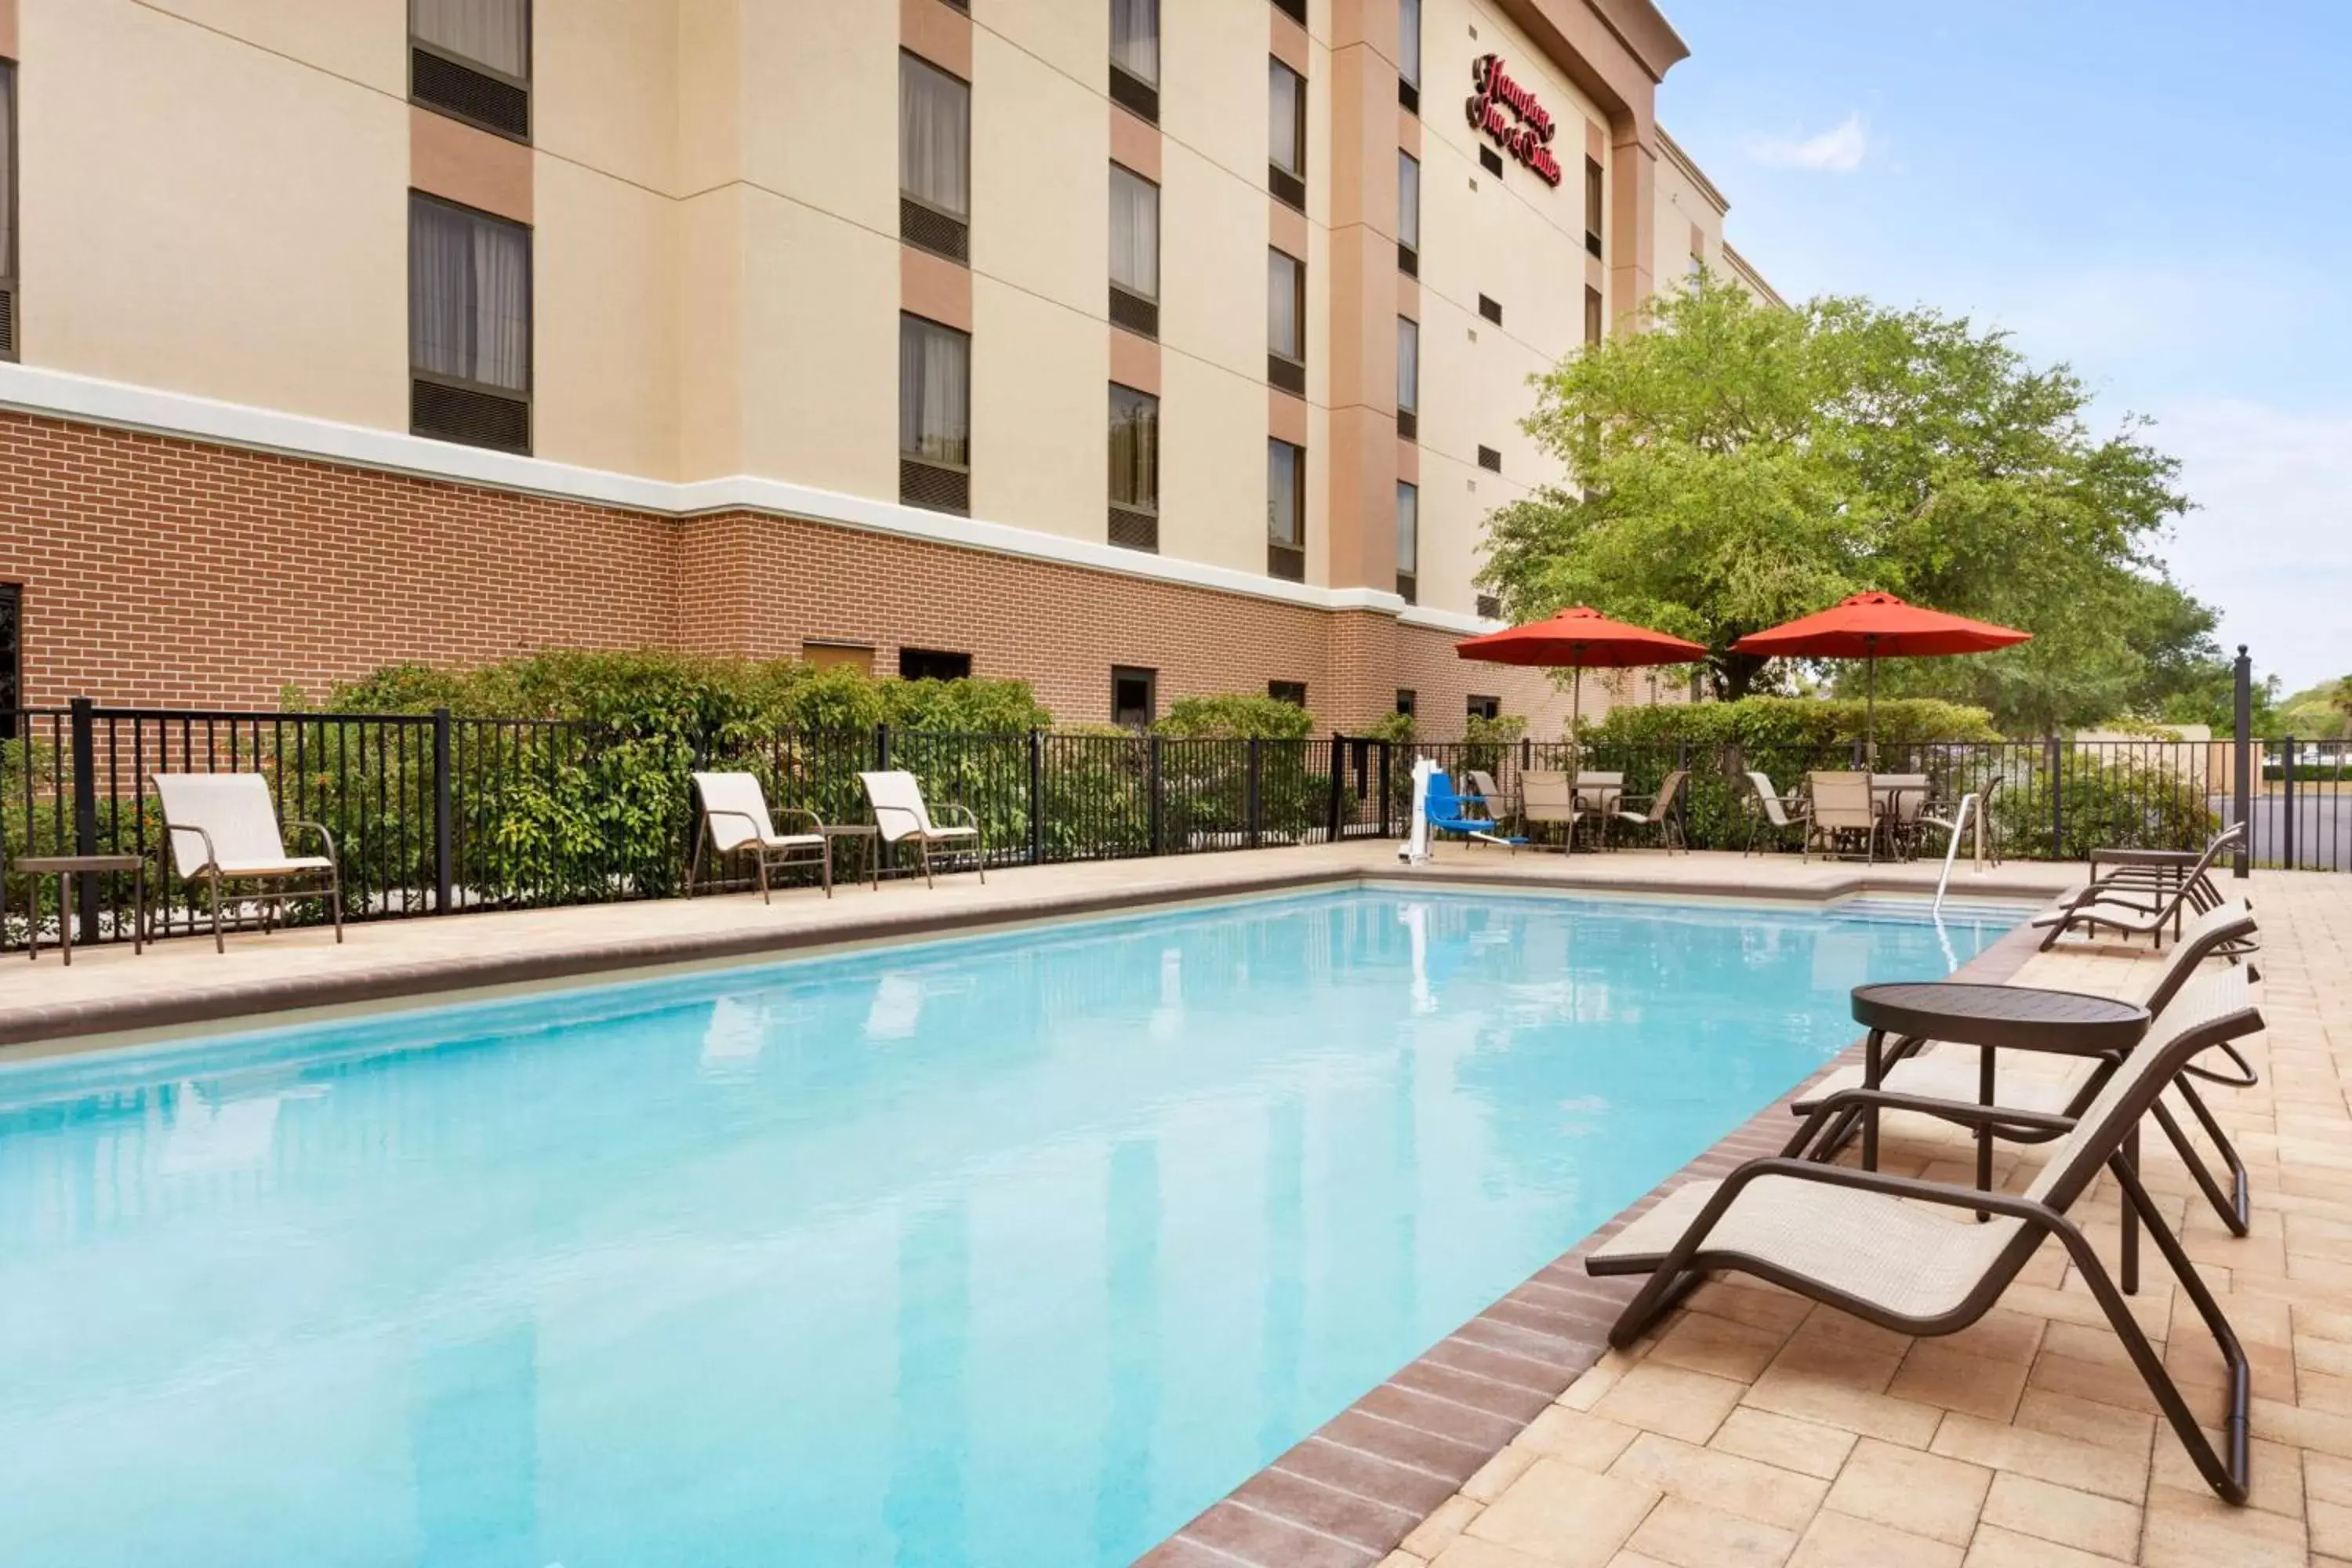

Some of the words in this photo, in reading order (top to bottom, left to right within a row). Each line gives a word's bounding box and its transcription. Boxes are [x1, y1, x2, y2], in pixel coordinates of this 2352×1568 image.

[1466, 96, 1511, 147] Inn
[1520, 131, 1561, 187] Suites
[1472, 54, 1555, 141] Hampton
